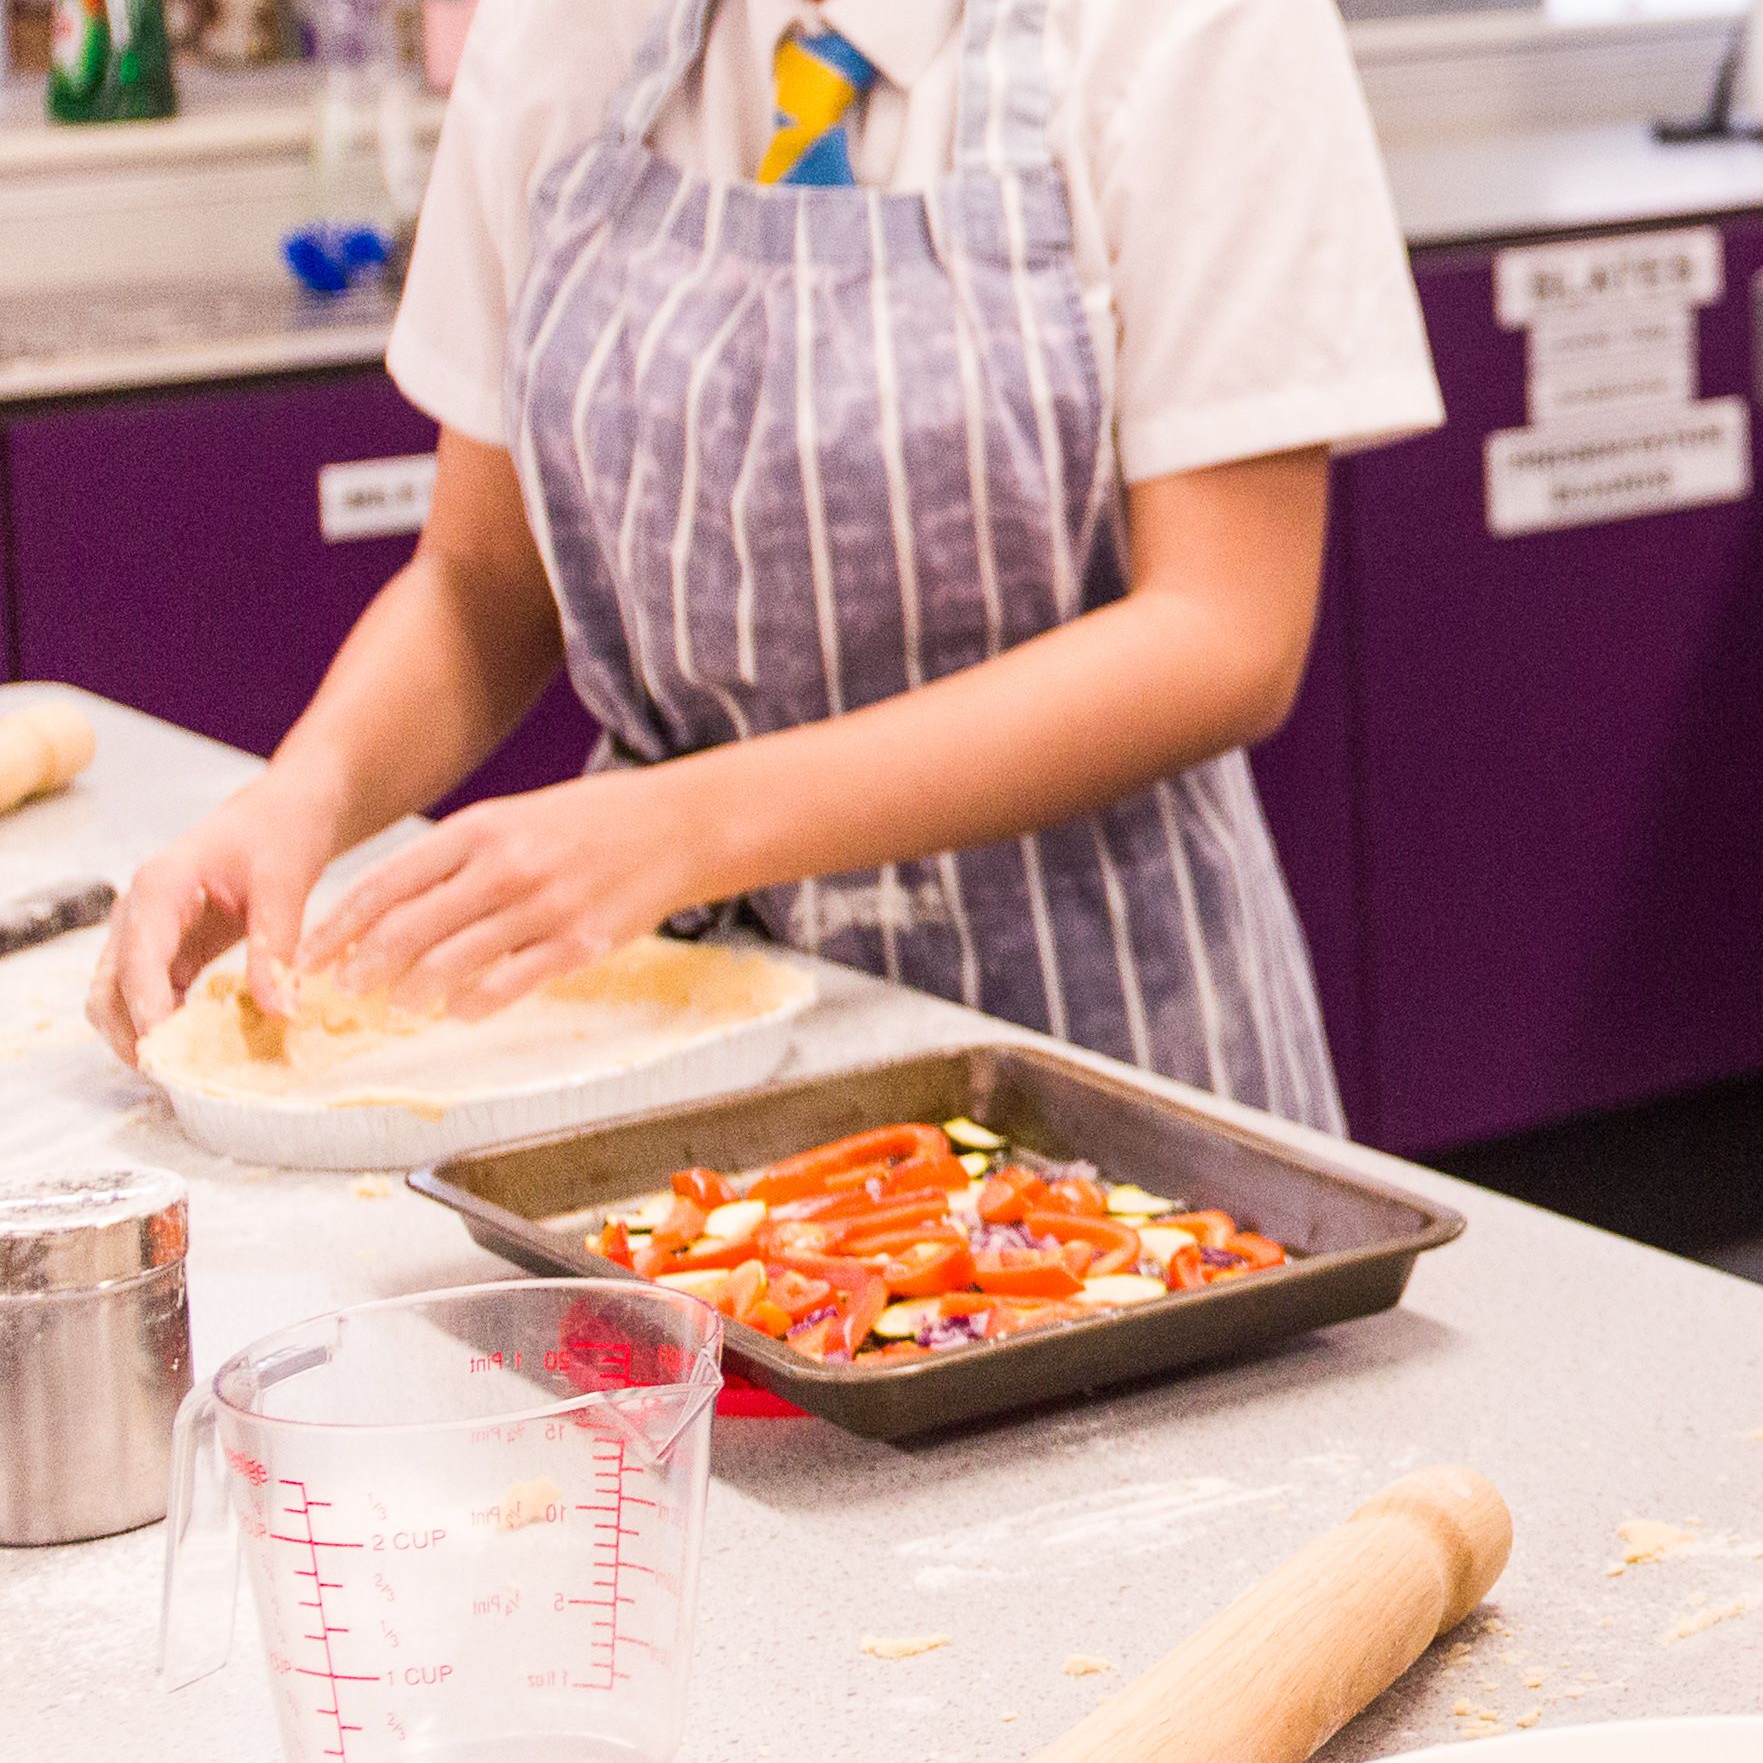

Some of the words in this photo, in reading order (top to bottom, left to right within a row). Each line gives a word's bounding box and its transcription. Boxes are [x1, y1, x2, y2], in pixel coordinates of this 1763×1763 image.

[372, 1533, 386, 1552] 2
[393, 1529, 447, 1551] CUP
[386, 1670, 395, 1687] 1
[404, 1665, 453, 1686] CUP
